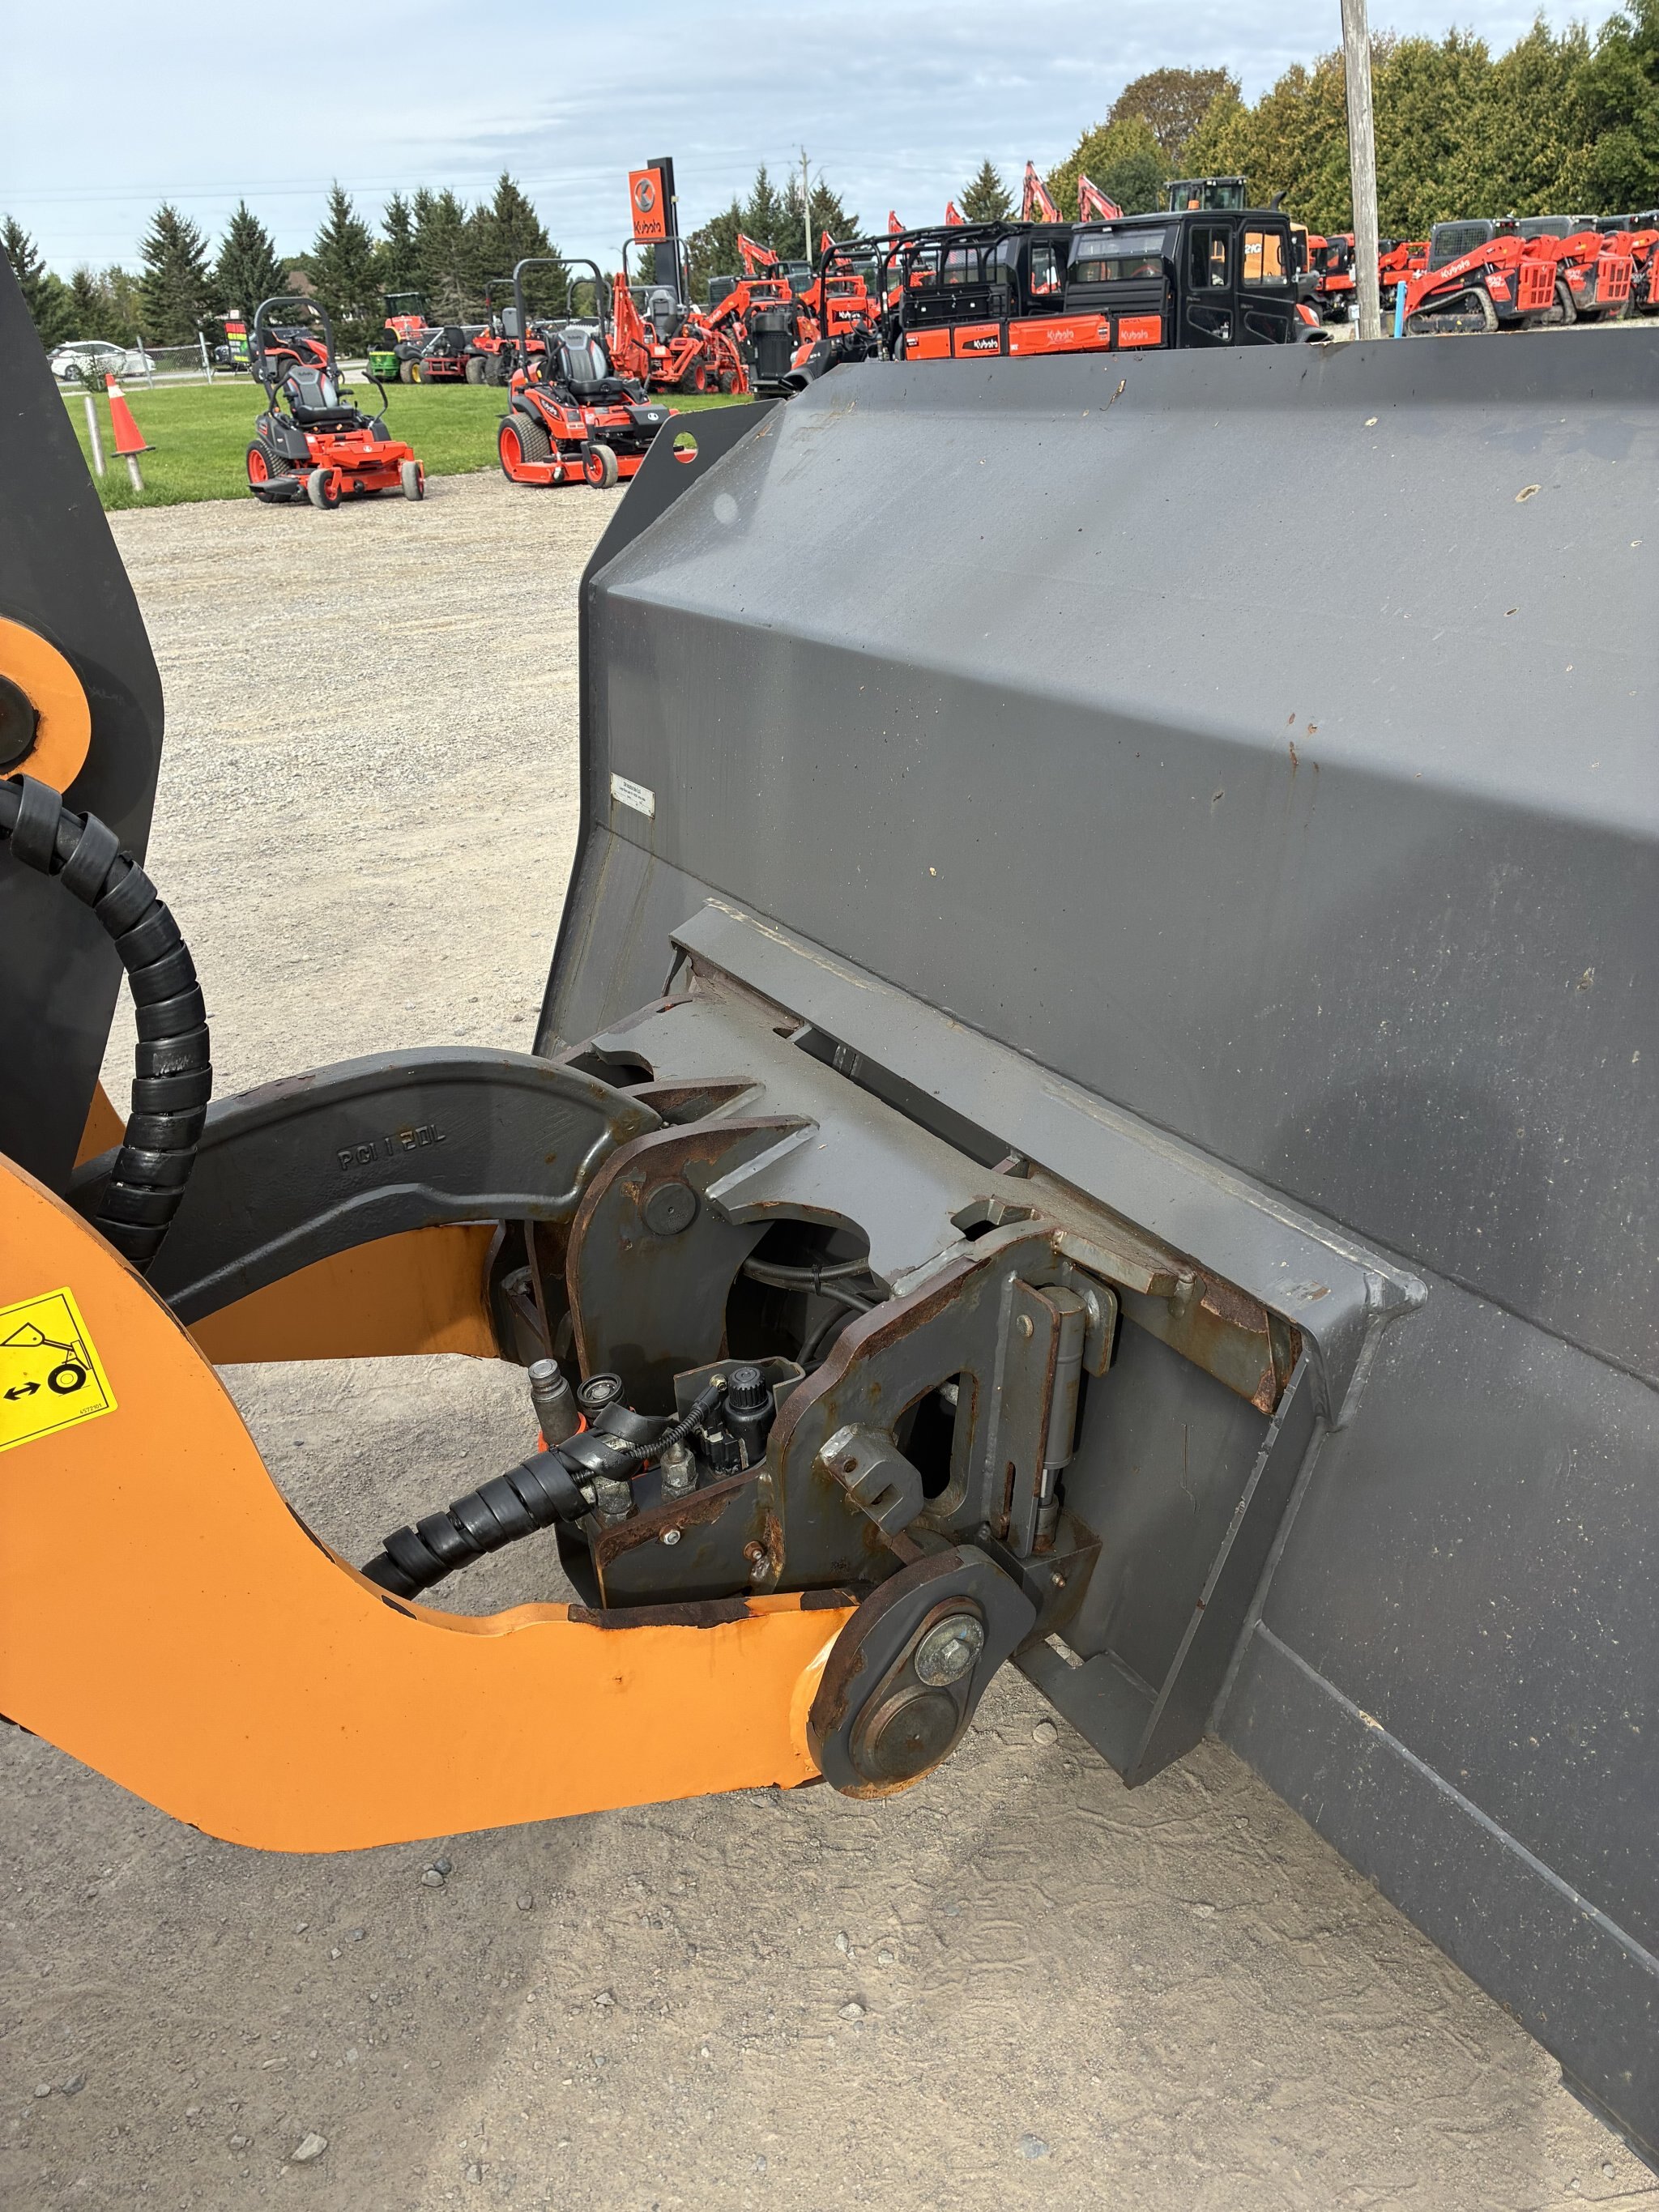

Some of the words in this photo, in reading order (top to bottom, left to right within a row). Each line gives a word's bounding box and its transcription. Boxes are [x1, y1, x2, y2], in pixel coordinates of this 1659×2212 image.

[634, 219, 662, 234] Kubota
[1440, 260, 1471, 278] Kubota
[1047, 328, 1074, 340] Kubota
[1121, 330, 1149, 340] Kubota
[974, 339, 998, 349] Kubota
